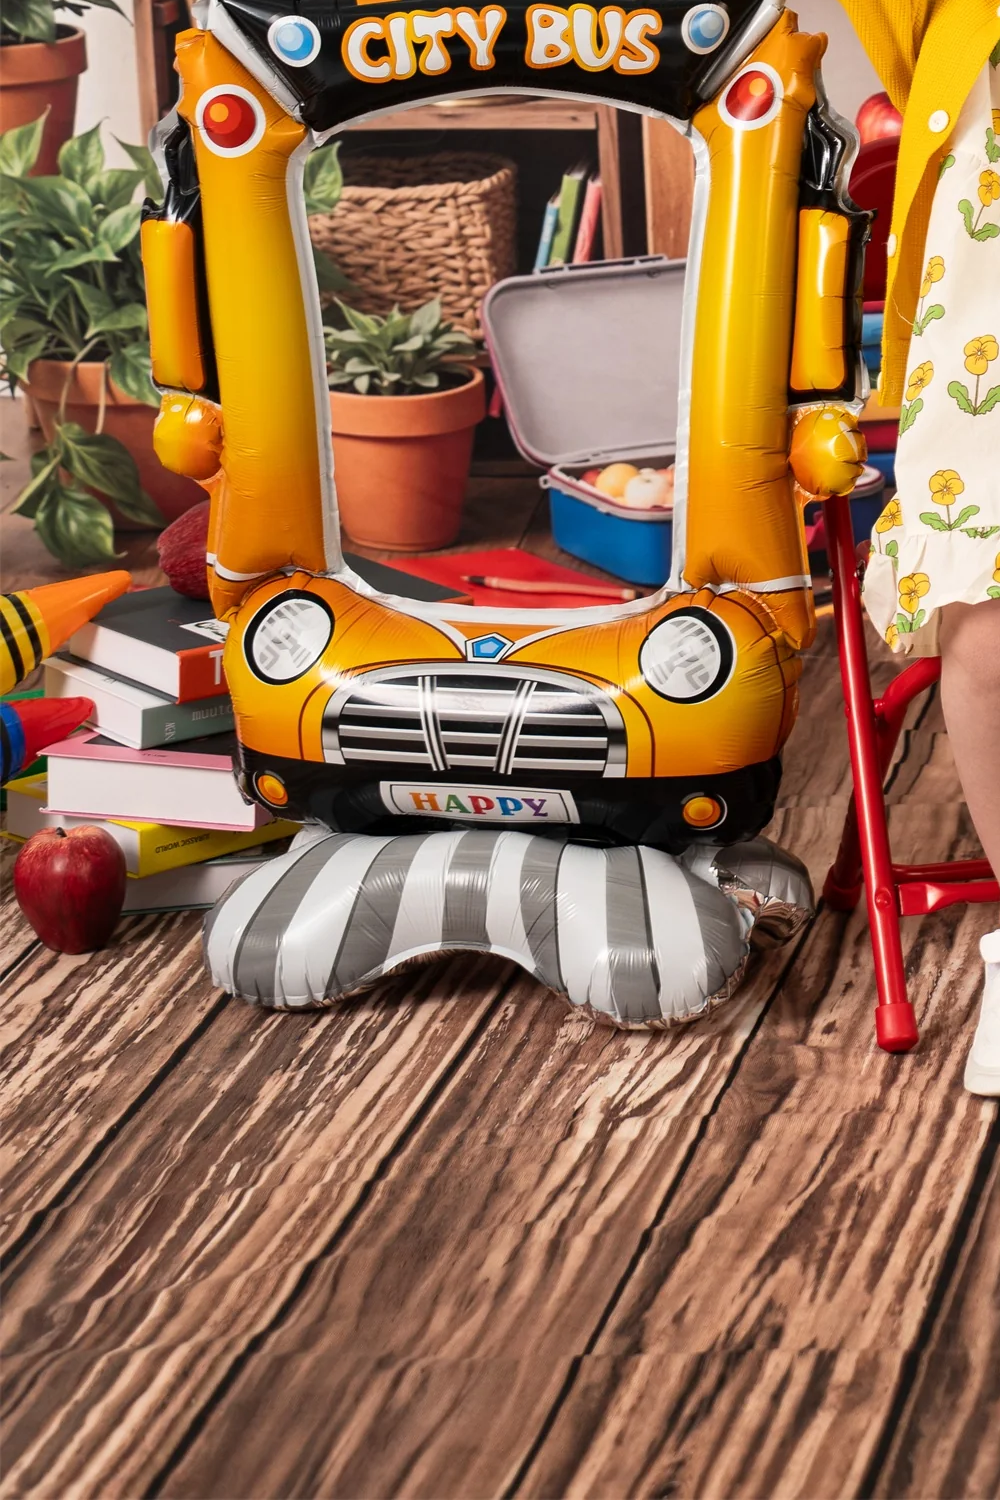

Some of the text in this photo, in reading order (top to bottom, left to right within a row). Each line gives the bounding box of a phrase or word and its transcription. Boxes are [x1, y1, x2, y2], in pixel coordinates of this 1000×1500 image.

[342, 3, 663, 84] CITY BUS
[409, 792, 548, 817] HAPPY
[154, 832, 210, 854] JURASSIC WORLD
